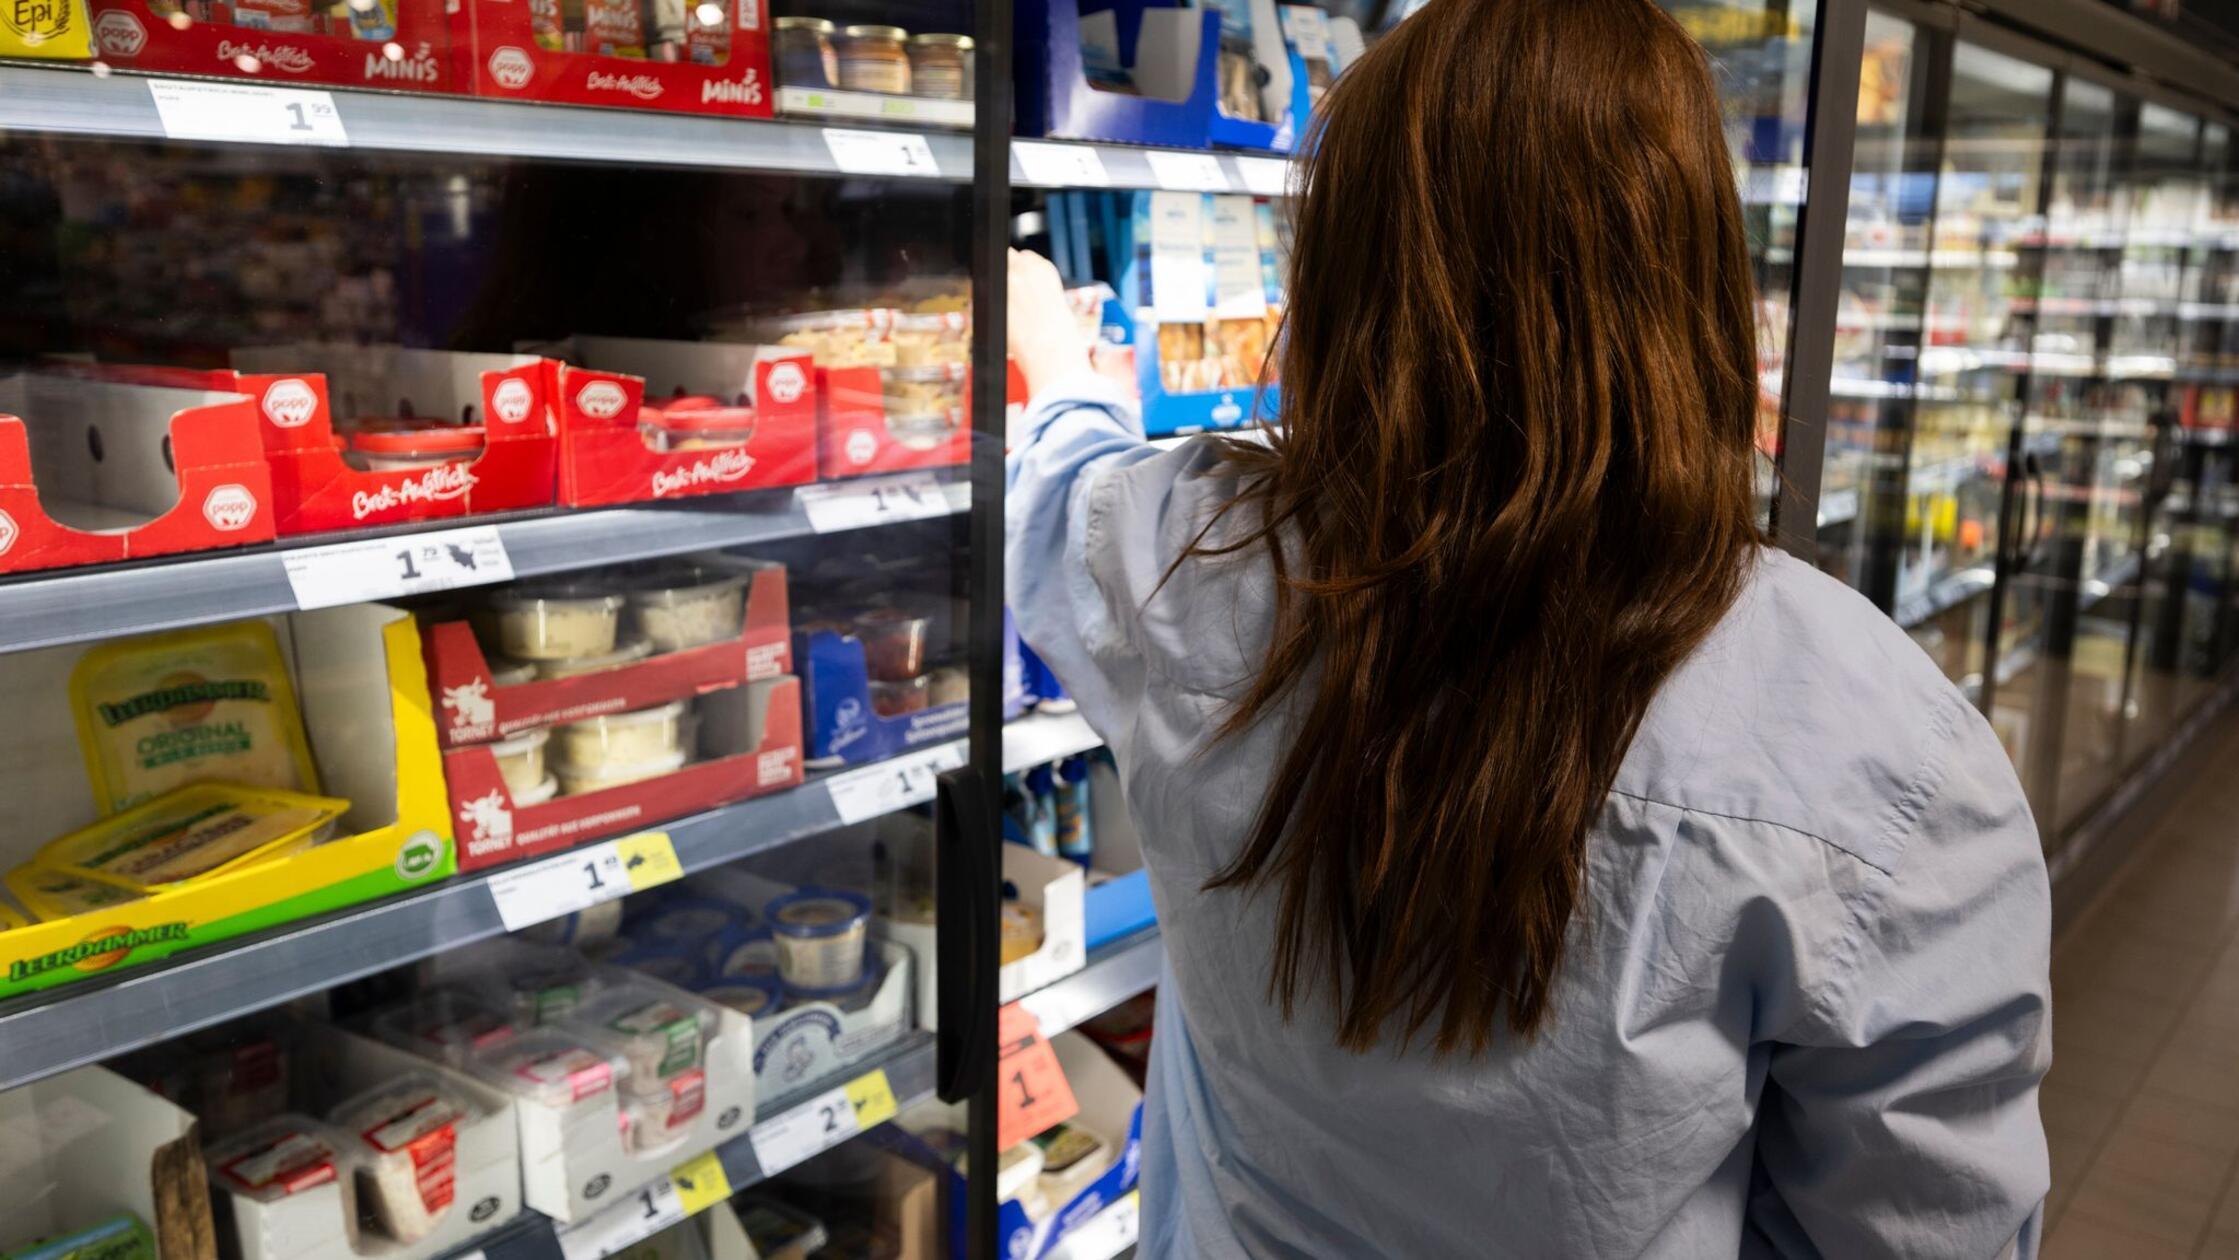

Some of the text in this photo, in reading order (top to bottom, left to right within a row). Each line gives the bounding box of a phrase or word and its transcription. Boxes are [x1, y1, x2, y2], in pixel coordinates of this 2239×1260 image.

[14, 0, 53, 32] Epi
[101, 27, 140, 42] popp
[286, 102, 314, 131] 1
[271, 398, 309, 412] popp
[212, 500, 249, 516] popp
[397, 549, 421, 580] 1
[137, 721, 244, 755] ORIGINAL
[583, 861, 605, 890] 1
[9, 922, 190, 982] LEERDAMMER
[1011, 1071, 1036, 1109] 1
[819, 1106, 838, 1133] 2
[638, 1189, 659, 1220] 1
